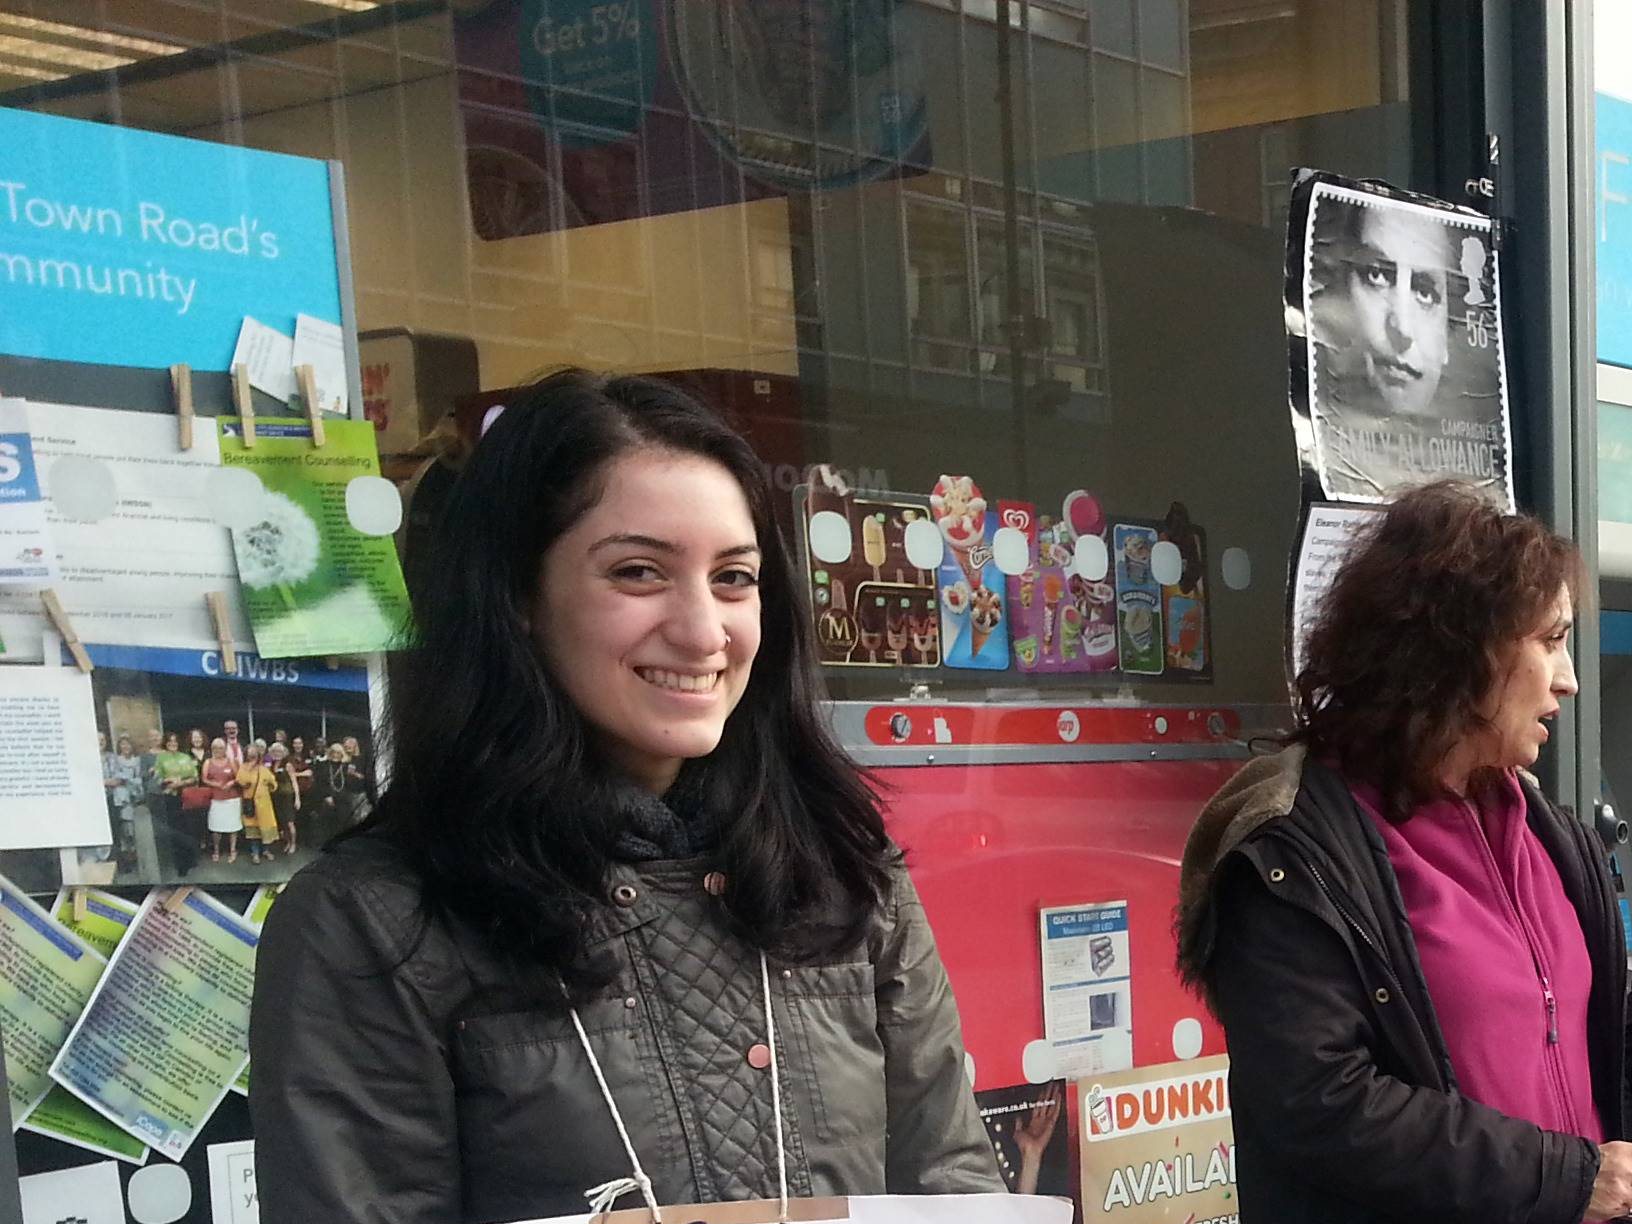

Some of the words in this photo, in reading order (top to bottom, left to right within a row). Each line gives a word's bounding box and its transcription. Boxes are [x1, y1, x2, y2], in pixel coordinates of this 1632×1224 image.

[1, 182, 123, 238] Town
[139, 201, 280, 259] Road's
[201, 650, 300, 684] CIWBS
